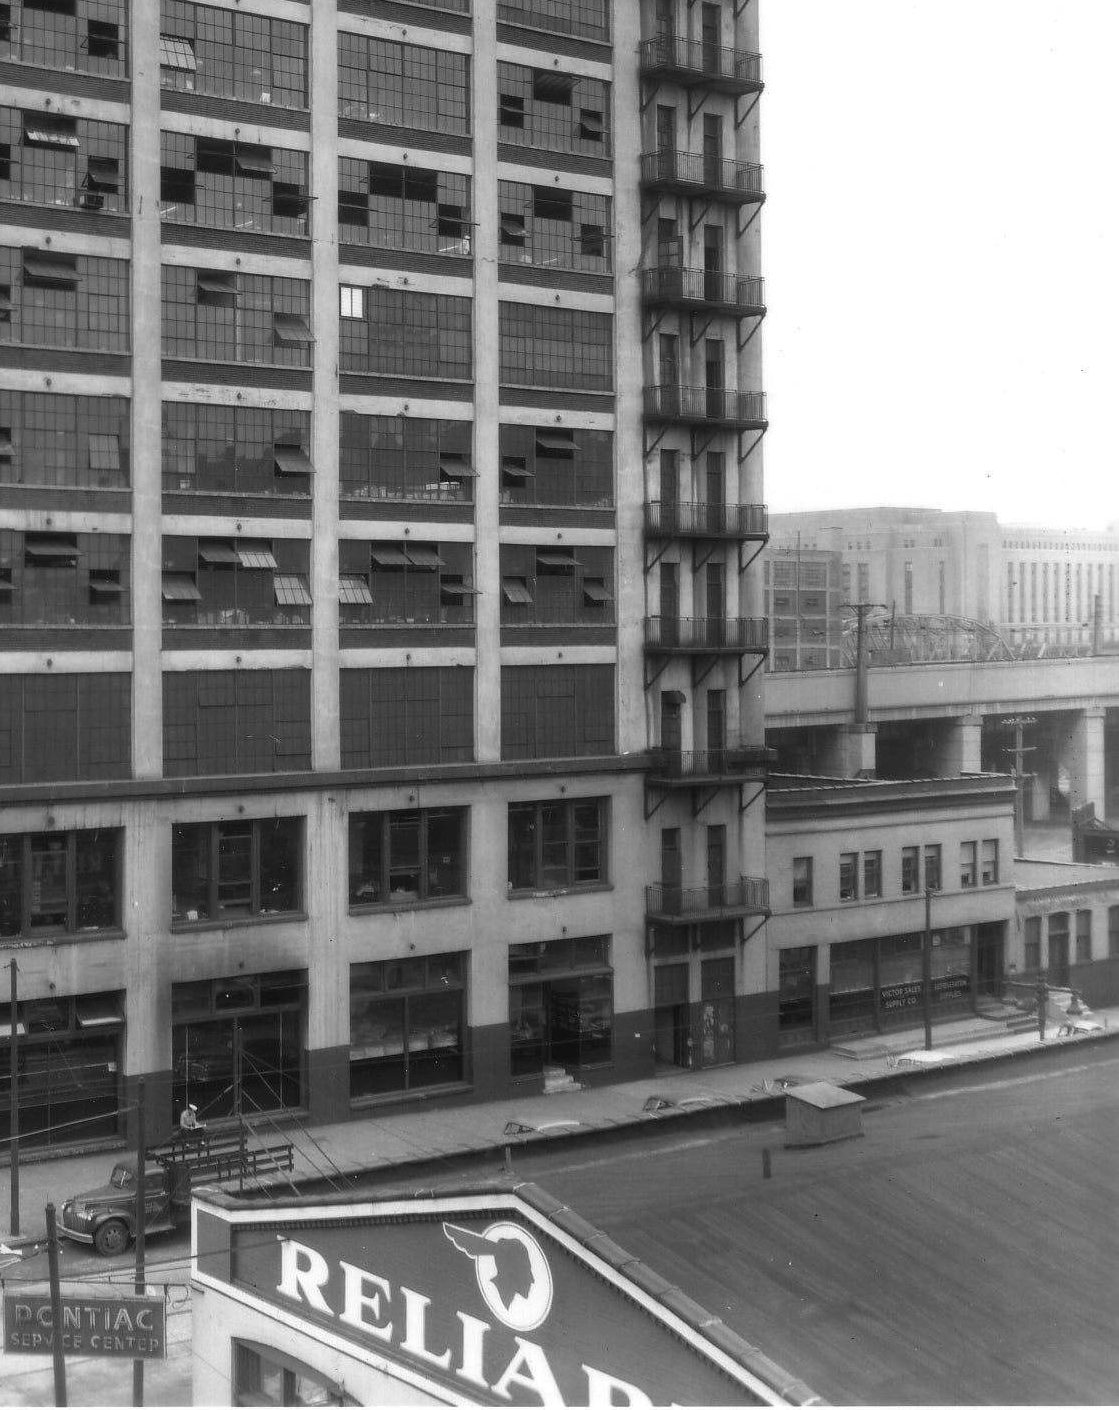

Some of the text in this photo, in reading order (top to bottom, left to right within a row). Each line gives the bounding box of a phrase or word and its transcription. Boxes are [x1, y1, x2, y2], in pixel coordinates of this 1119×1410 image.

[881, 985, 922, 998] VICTOR SALES
[885, 998, 906, 1009] SUPPLY
[15, 1304, 154, 1331] PONTIAC
[10, 1332, 159, 1352] SERVCE CENTER
